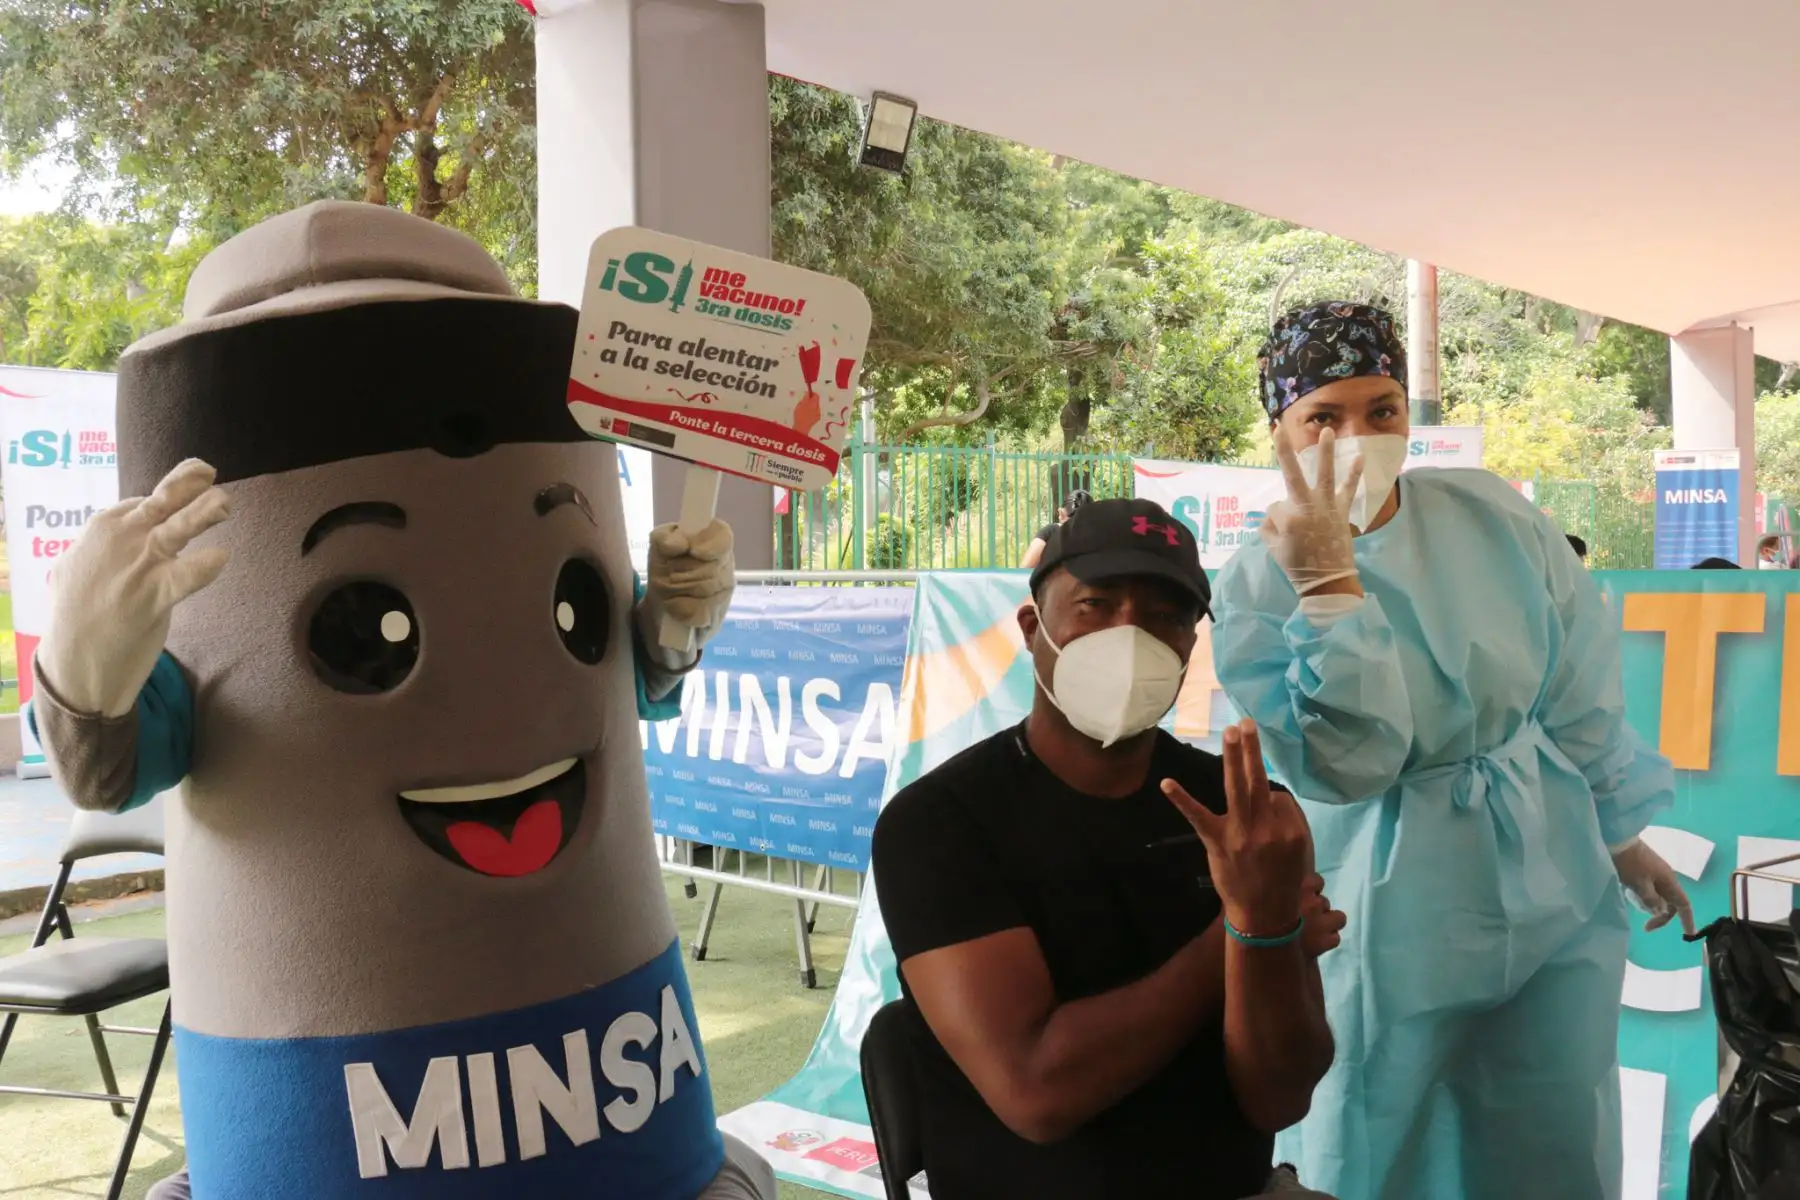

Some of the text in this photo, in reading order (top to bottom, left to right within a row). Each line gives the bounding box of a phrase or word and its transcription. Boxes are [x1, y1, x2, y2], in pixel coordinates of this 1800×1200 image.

[703, 267, 746, 288] me
[700, 281, 806, 316] vacuno!
[695, 298, 793, 331] 3ra dosis
[608, 321, 779, 373] Para alentar
[600, 348, 777, 398] a la selección
[80, 431, 108, 442] me
[669, 411, 826, 462] Ponte la tercera dosis
[79, 454, 103, 465] 3ra
[767, 459, 805, 476] Siempre
[1216, 496, 1238, 511] me
[1665, 489, 1728, 504] MINSA
[26, 504, 106, 529] Pont
[1215, 530, 1234, 546] 3ra
[813, 622, 841, 634] MINSA
[857, 624, 887, 635] MINSA
[830, 652, 859, 665] MINSA
[874, 654, 904, 667] MINSA
[639, 669, 899, 778] MINSA
[782, 786, 811, 800] MINSA
[824, 792, 853, 805] MINSA
[769, 813, 796, 826] MINSA
[808, 819, 837, 833] MINSA
[344, 984, 701, 1179] MINSA
